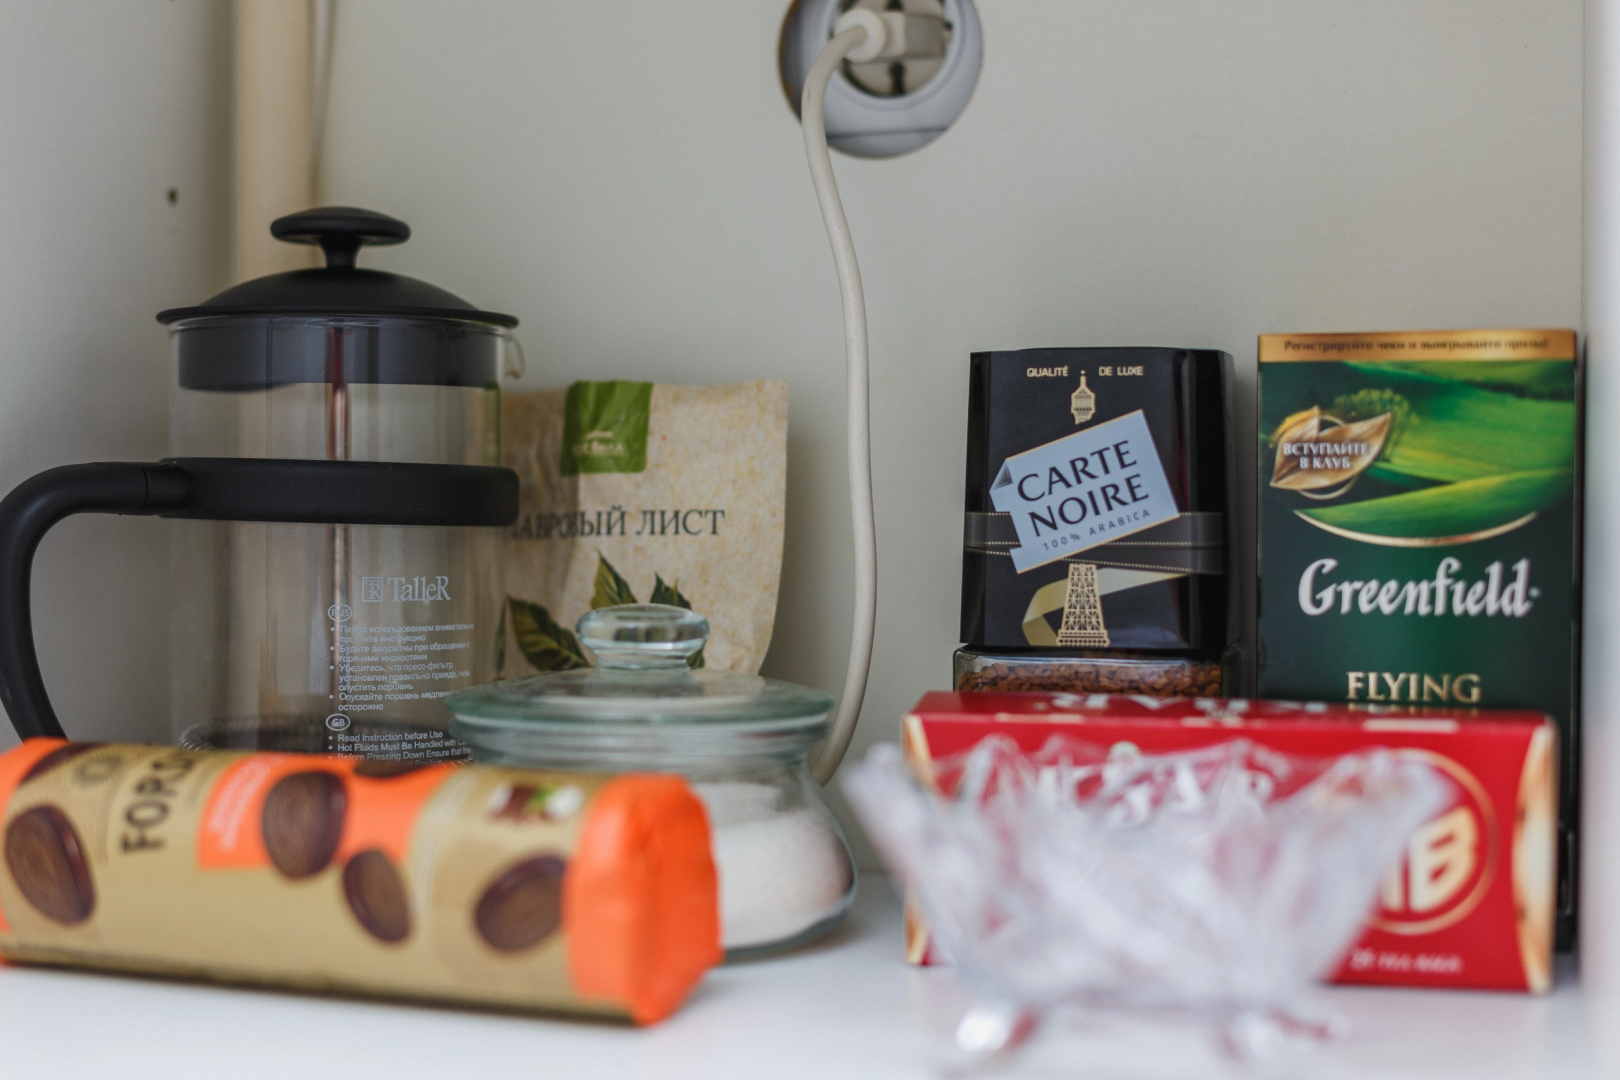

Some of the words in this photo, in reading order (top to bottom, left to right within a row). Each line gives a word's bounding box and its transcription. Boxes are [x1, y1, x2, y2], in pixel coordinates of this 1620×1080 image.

[1026, 365, 1068, 377] QUALITÉ
[1098, 366, 1113, 377] DE
[1117, 365, 1144, 376] LUXE
[1283, 440, 1368, 456] ВСТУПАЙТЕ
[1300, 456, 1310, 469] В
[1312, 456, 1351, 470] КЛУБ
[1017, 440, 1138, 502] CARTE
[1027, 473, 1149, 538] NOIRE
[636, 509, 726, 537] ЛИСТ
[1042, 533, 1081, 551] 100%
[1089, 509, 1150, 536] ARABICA
[387, 575, 451, 601] TalleR
[1298, 556, 1533, 618] Greenfield
[331, 608, 350, 617] RUS
[340, 625, 368, 635] Перед
[369, 624, 434, 634] использованием
[435, 622, 475, 631] внимательно
[380, 634, 426, 645] инструкцию
[339, 644, 370, 654] Будьте
[371, 645, 413, 654] аккуратны
[414, 645, 428, 653] при
[430, 642, 466, 651] обращении
[339, 655, 379, 664] горячими
[380, 654, 428, 663] жидкостями
[339, 664, 386, 673] Убедитесь,
[388, 664, 402, 672] что
[403, 662, 454, 672] пресс-фильтр
[339, 674, 388, 684] установлен
[389, 673, 431, 683] правильно
[458, 670, 471, 678] чем
[338, 684, 377, 694] опустить
[378, 683, 414, 693] поршень
[1345, 671, 1482, 703] FLYING
[339, 692, 383, 703] Опускайте
[384, 692, 419, 702] поршень
[338, 703, 384, 712] осторожно
[331, 718, 346, 727] GB
[337, 733, 360, 742] Read
[362, 732, 403, 742] Instruction
[404, 731, 428, 741] before
[429, 730, 444, 739] Use
[337, 743, 353, 752] Hot
[354, 742, 379, 752] Fluids
[380, 742, 400, 751] Must
[401, 741, 412, 750] Be
[414, 740, 444, 750] Handled
[444, 738, 457, 747] with
[366, 752, 402, 762] Pressing
[403, 751, 425, 760] Down
[426, 749, 450, 758] Ensure
[450, 747, 462, 756] that
